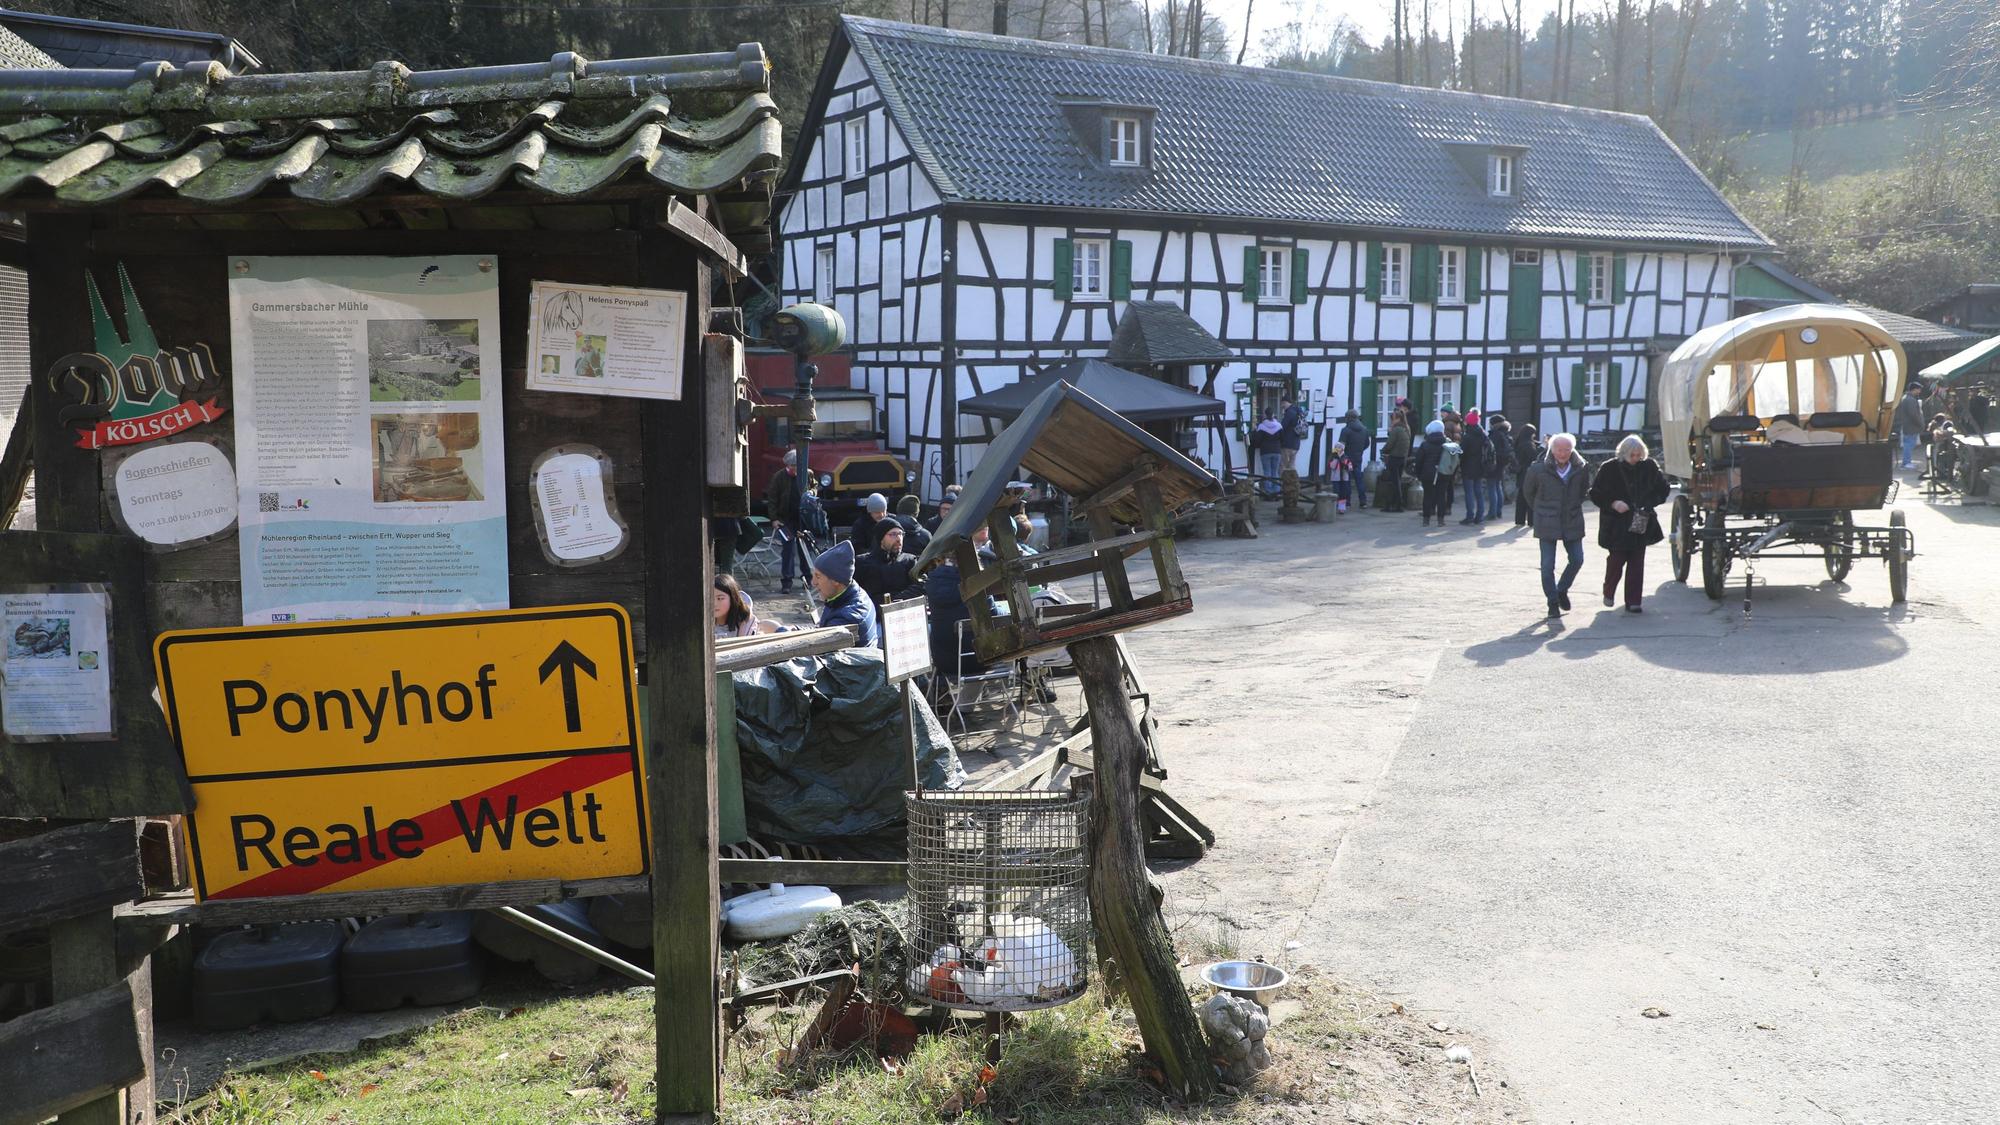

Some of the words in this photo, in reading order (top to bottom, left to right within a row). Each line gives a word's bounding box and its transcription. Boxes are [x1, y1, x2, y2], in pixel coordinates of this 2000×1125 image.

[252, 302, 336, 312] Gammersbacher
[338, 302, 368, 310] Mühle
[588, 296, 614, 304] Helens
[614, 298, 649, 307] Ponyspaß
[48, 341, 222, 428] Dom
[106, 408, 192, 442] KÖLSCH
[124, 456, 210, 479] Bogenschießen
[130, 488, 183, 506] Sonntags
[215, 506, 228, 514] Uhr
[396, 532, 422, 540] Wupper
[436, 532, 451, 540] Sieg
[222, 663, 498, 744] Ponyhof
[230, 806, 424, 873] Reale
[450, 790, 606, 854] Welt
